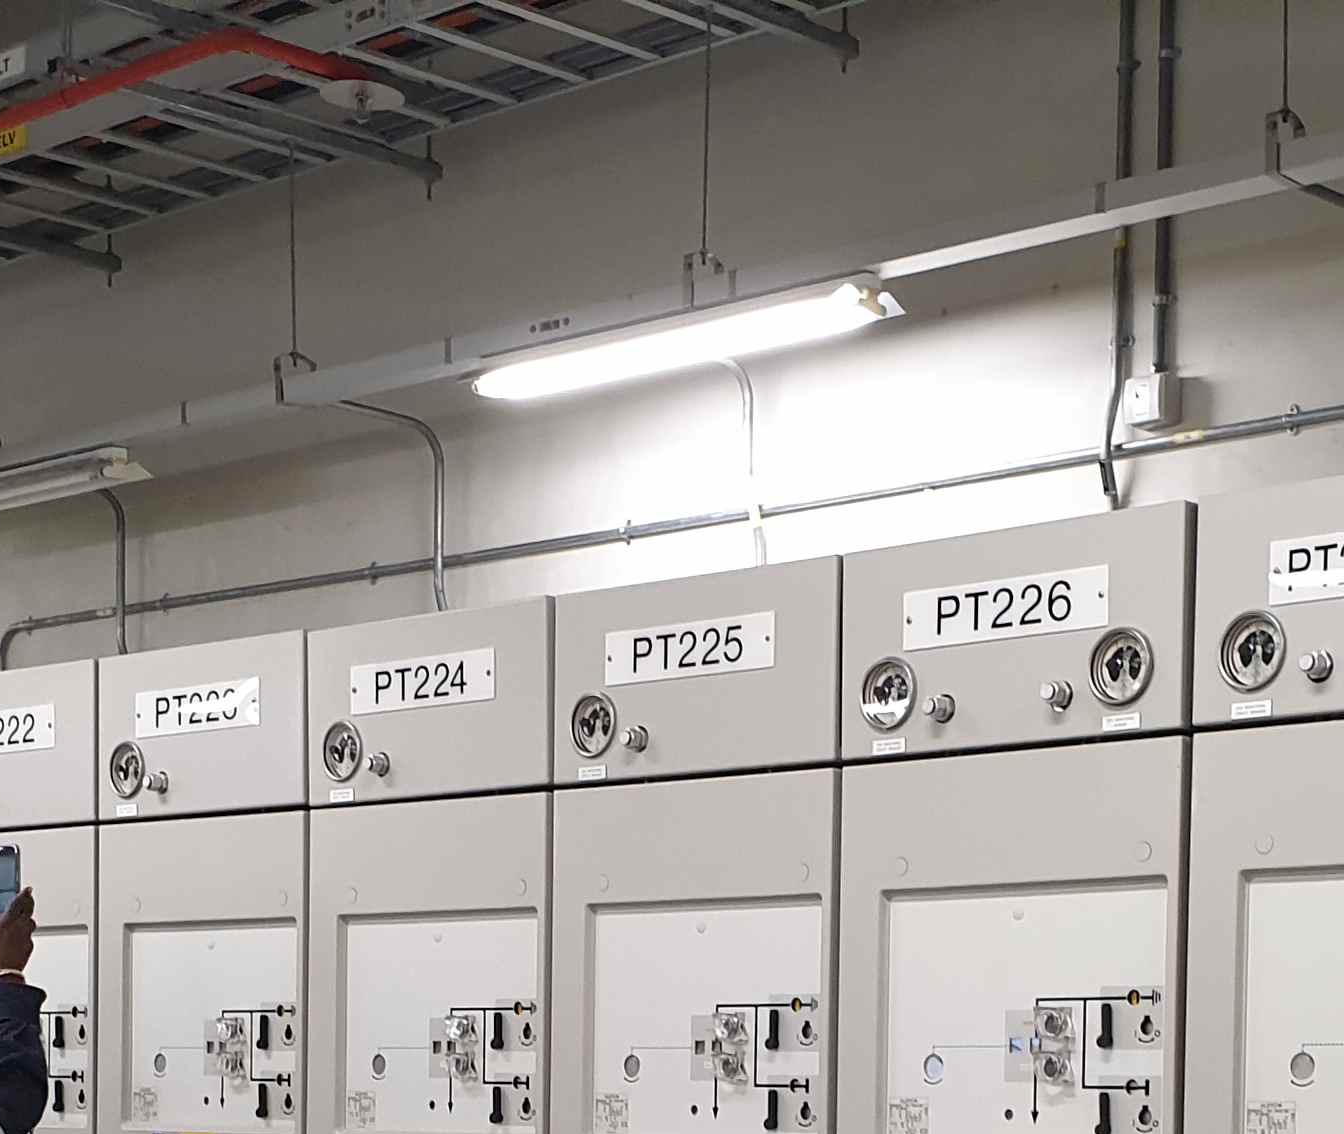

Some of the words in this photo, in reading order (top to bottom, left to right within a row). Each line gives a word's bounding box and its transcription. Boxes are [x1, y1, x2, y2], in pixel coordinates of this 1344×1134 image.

[936, 580, 1072, 635] PT226
[632, 624, 743, 674] PT225
[374, 661, 467, 705] PT224
